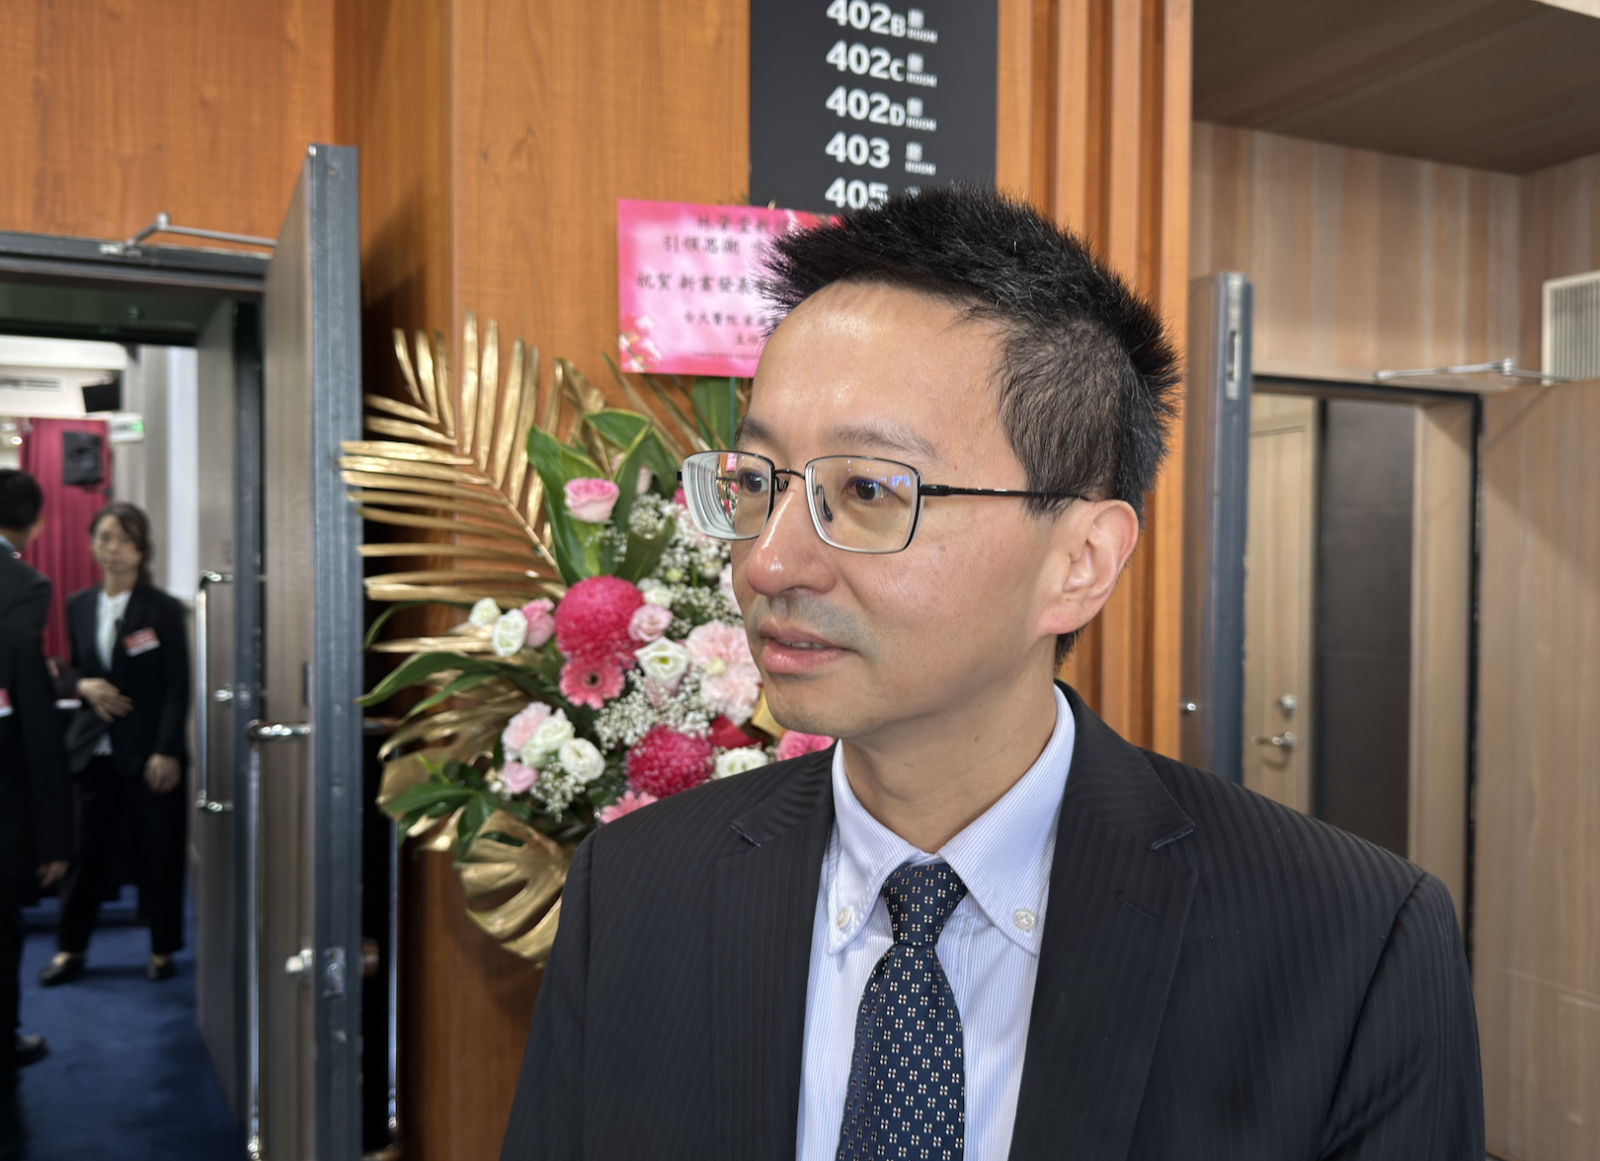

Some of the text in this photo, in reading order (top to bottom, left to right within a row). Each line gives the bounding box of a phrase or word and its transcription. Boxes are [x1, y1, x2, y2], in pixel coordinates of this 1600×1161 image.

[826, 0, 906, 37] 402B
[825, 39, 905, 82] 402C
[825, 85, 906, 126] 402D
[825, 131, 890, 169] 403
[824, 177, 889, 211] 405
